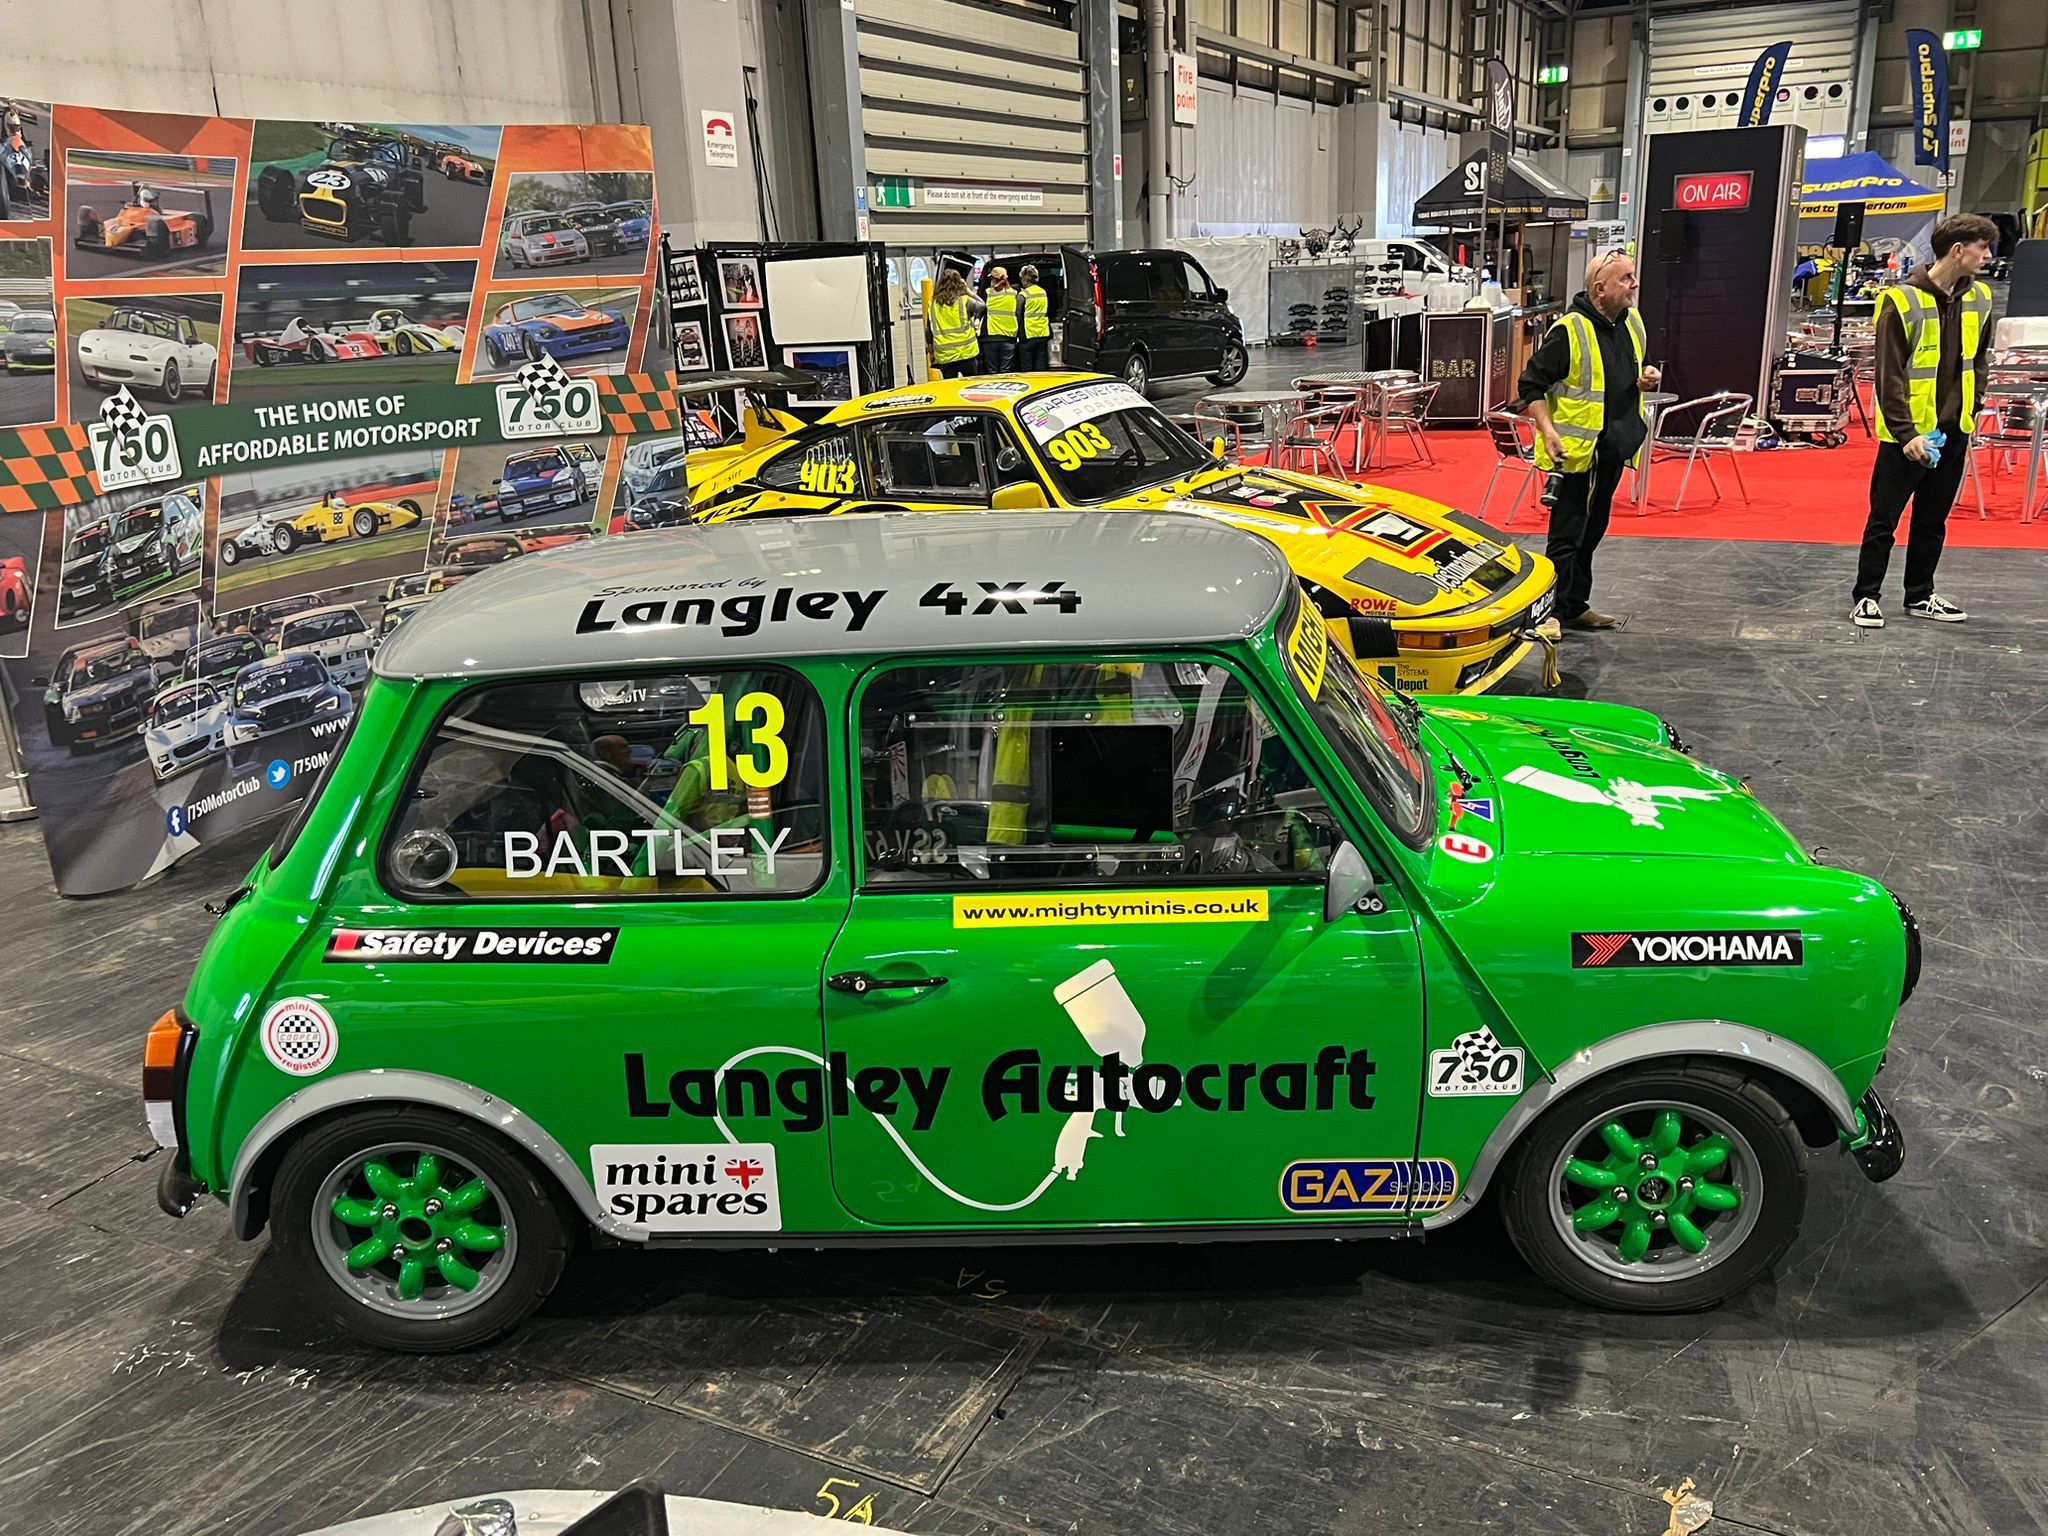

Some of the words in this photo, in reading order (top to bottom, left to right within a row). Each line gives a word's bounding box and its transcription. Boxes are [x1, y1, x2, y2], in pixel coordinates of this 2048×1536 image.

[1178, 64, 1193, 85] Fire
[1918, 43, 1938, 126] superpro
[1176, 92, 1196, 111] point
[1749, 57, 1776, 126] uperpro
[1951, 127, 1963, 135] re
[707, 141, 735, 150] Emergency
[709, 150, 735, 159] Telephone
[309, 172, 346, 188] 23
[927, 189, 943, 198] Please
[951, 191, 959, 199] not
[972, 191, 983, 200] front
[997, 194, 1020, 202] emergency
[1021, 193, 1029, 201] exit
[1029, 193, 1041, 201] doors
[1683, 184, 1709, 203] ON
[1712, 182, 1742, 202] AIR
[1823, 204, 1835, 213] to
[1864, 201, 1907, 210] erform
[500, 332, 516, 351] 240
[1432, 359, 1476, 378] BAR
[254, 405, 299, 428] THE
[303, 398, 371, 425] HOME
[376, 395, 405, 417] OF
[506, 386, 591, 423] 750
[508, 422, 551, 432] MOTOR
[559, 419, 592, 429] CLUB
[96, 423, 169, 472] 750
[198, 429, 329, 468] AFFORDABLE
[334, 417, 481, 450] MOTORSPORT
[1048, 422, 1112, 472] 903
[103, 469, 137, 483] MOTOR
[143, 463, 173, 477] CLUB
[799, 458, 857, 494] 903
[594, 579, 733, 598] Sponsored
[738, 577, 767, 590] by
[575, 587, 889, 638] Langley
[919, 581, 1082, 616] 4X4
[1350, 598, 1398, 611] ROWE
[1397, 678, 1429, 692] Depot
[689, 691, 789, 791] 13
[187, 777, 260, 823] /750MotorClub
[504, 827, 792, 878] BARTLEY
[1445, 837, 1486, 859] E
[962, 898, 1260, 921] www.mightyminis.co.uk
[361, 932, 465, 960] Safety
[1631, 935, 1793, 961] YOKOHAMA
[285, 1001, 310, 1012] mini
[279, 1033, 319, 1041] COOPER
[282, 1058, 321, 1071] register
[1437, 1053, 1518, 1085] 750
[624, 1051, 952, 1133] Langley
[981, 1045, 1377, 1123] Autocraft
[1434, 1084, 1477, 1092] MOTOR
[606, 1154, 718, 1186] mini
[1290, 1168, 1394, 1204] GAZ
[1389, 1181, 1452, 1193] SHOCKS
[610, 1190, 768, 1224] spares
